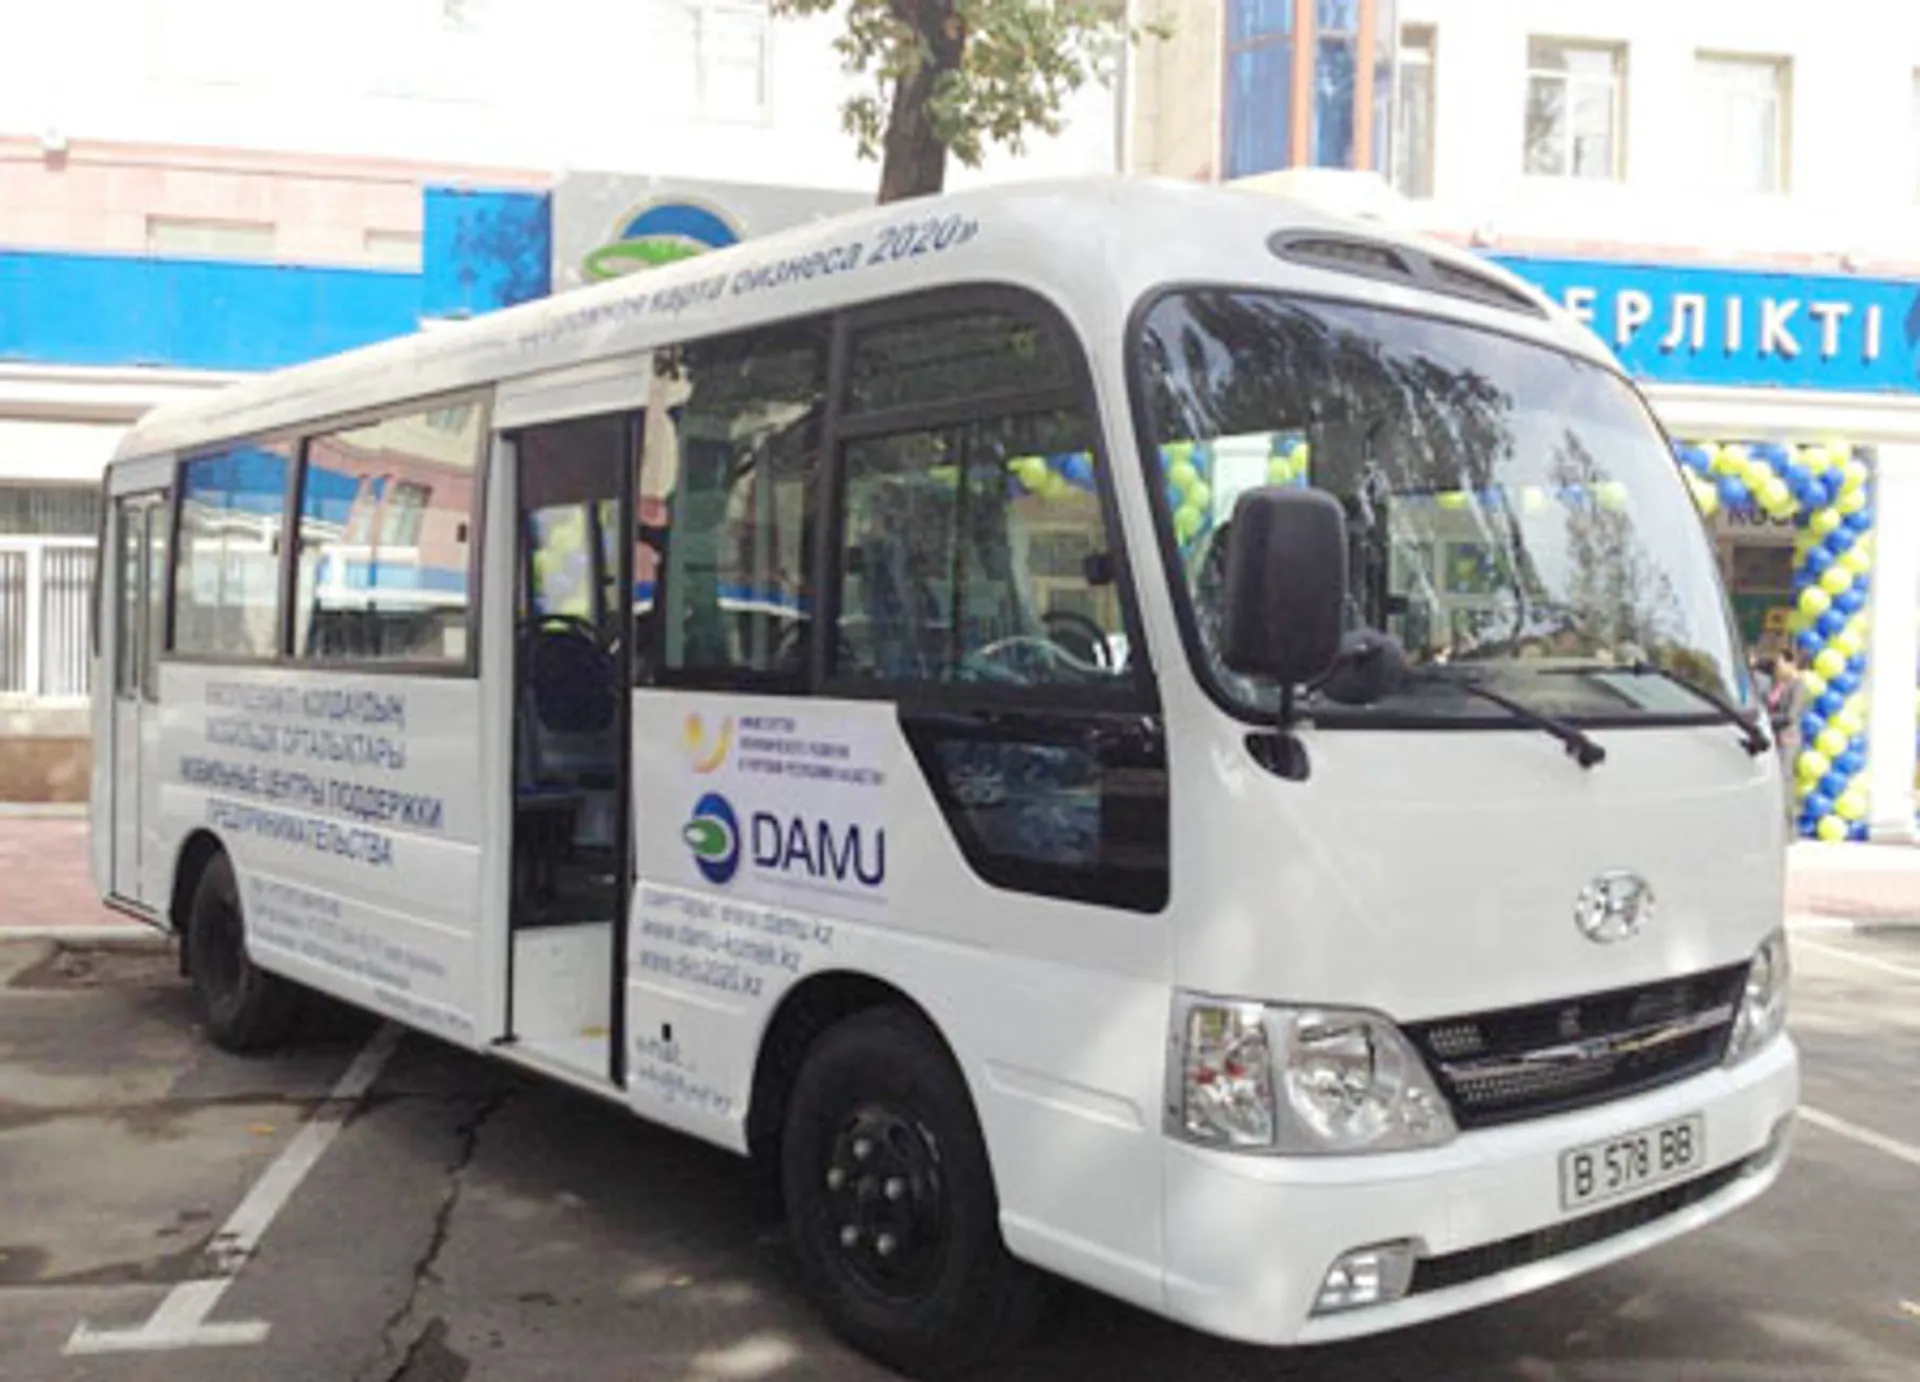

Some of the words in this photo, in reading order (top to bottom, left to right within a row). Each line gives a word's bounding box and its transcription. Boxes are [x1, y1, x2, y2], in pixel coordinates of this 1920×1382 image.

[328, 779, 444, 828] ПОДДЕРЖКИ
[752, 811, 885, 885] DAMU
[1574, 1153, 1594, 1197] B
[1604, 1137, 1650, 1190] 578
[1660, 1124, 1693, 1171] BB
